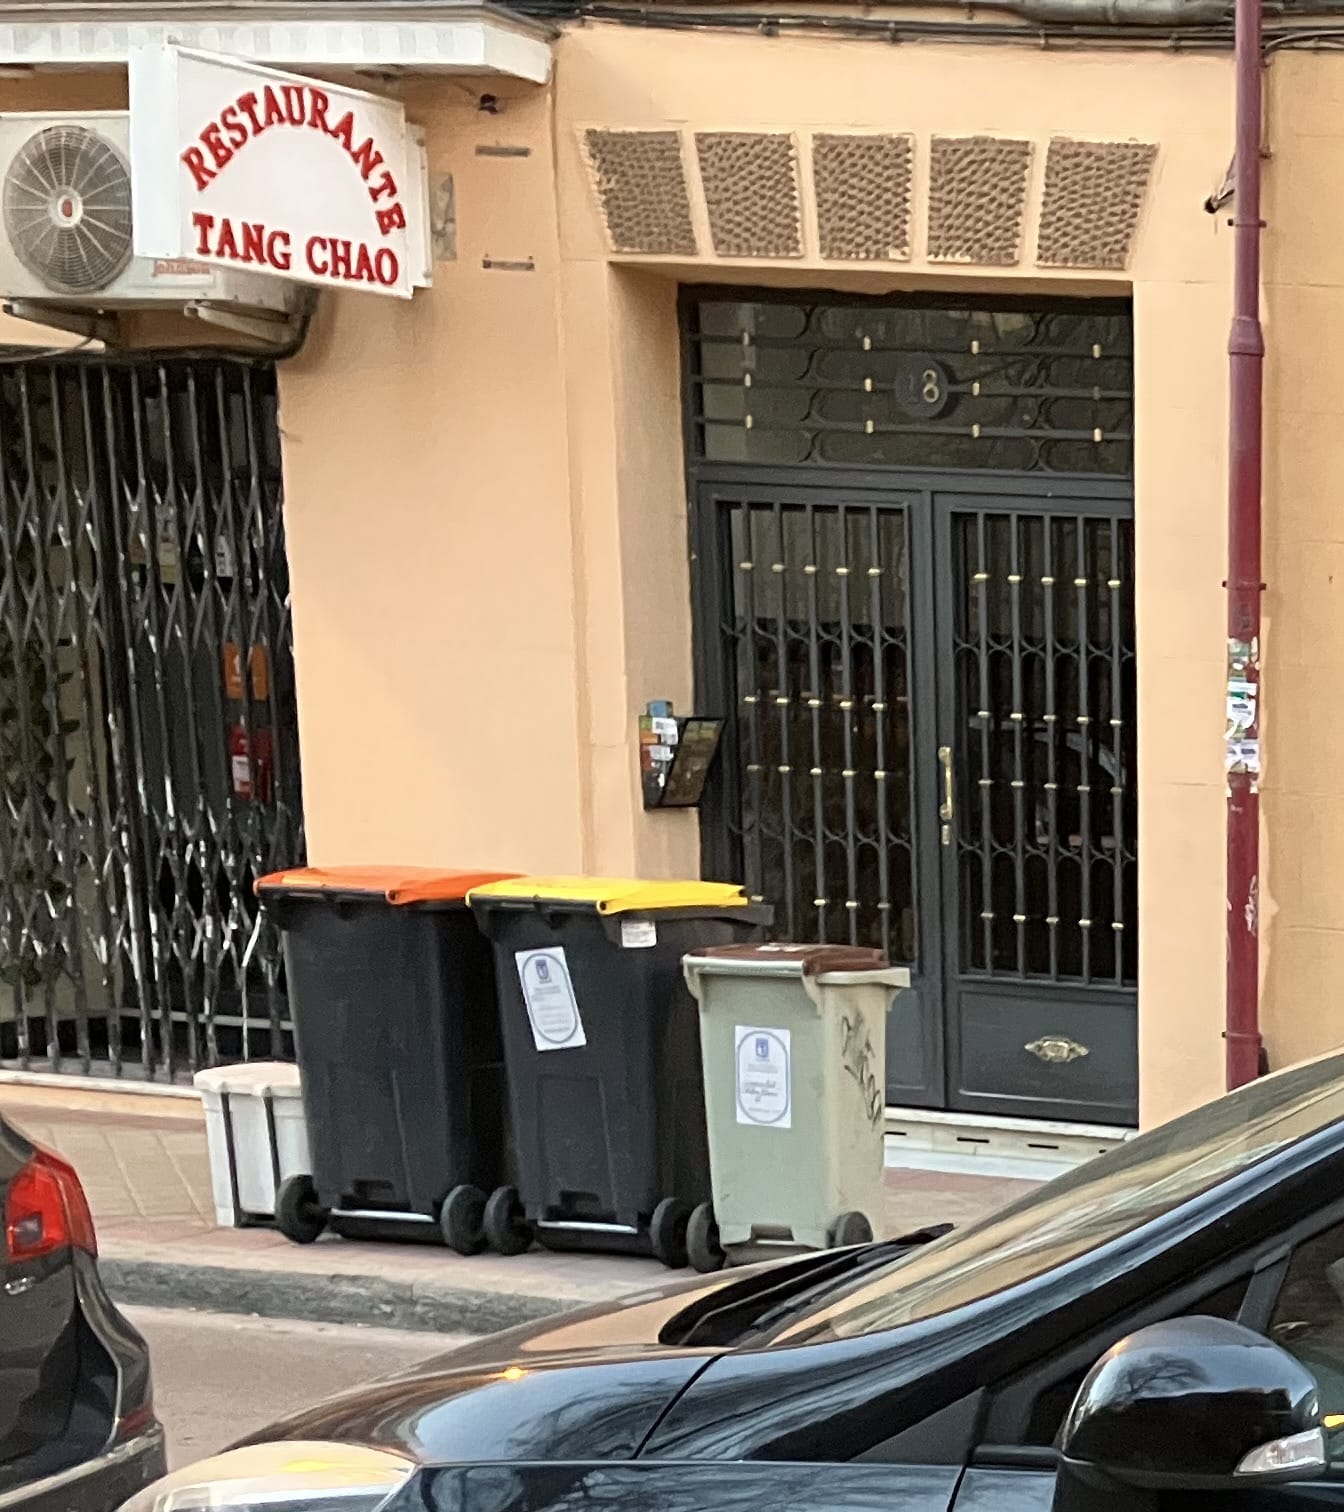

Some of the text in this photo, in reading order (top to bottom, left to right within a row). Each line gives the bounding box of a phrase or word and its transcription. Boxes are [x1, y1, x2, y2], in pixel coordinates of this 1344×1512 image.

[180, 84, 407, 236] RESTAURANTE
[191, 211, 400, 287] TANG CHAO
